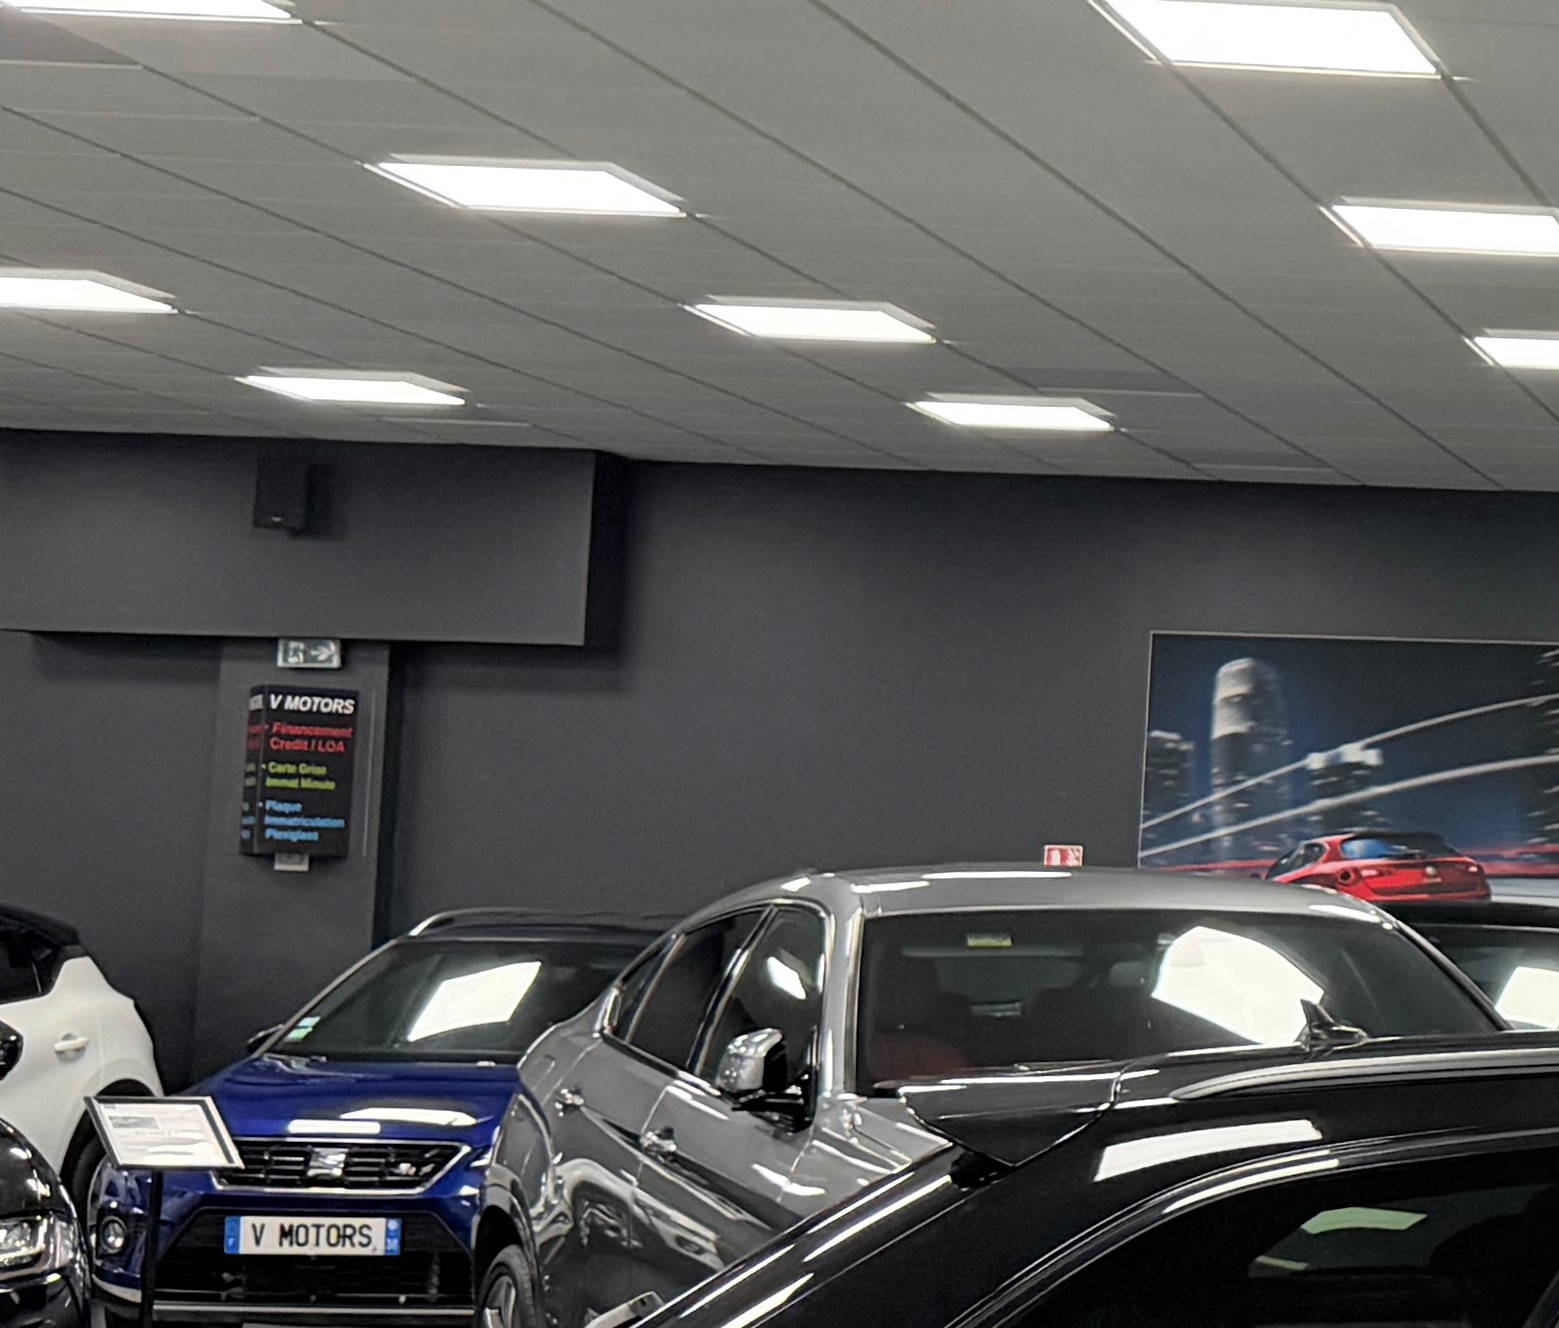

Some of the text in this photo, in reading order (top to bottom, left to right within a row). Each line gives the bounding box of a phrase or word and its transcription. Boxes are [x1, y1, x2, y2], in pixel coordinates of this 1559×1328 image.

[269, 693, 283, 710] V
[284, 695, 355, 714] MOTORS
[317, 740, 345, 753] LOA
[251, 1223, 373, 1249] V MOTORS
